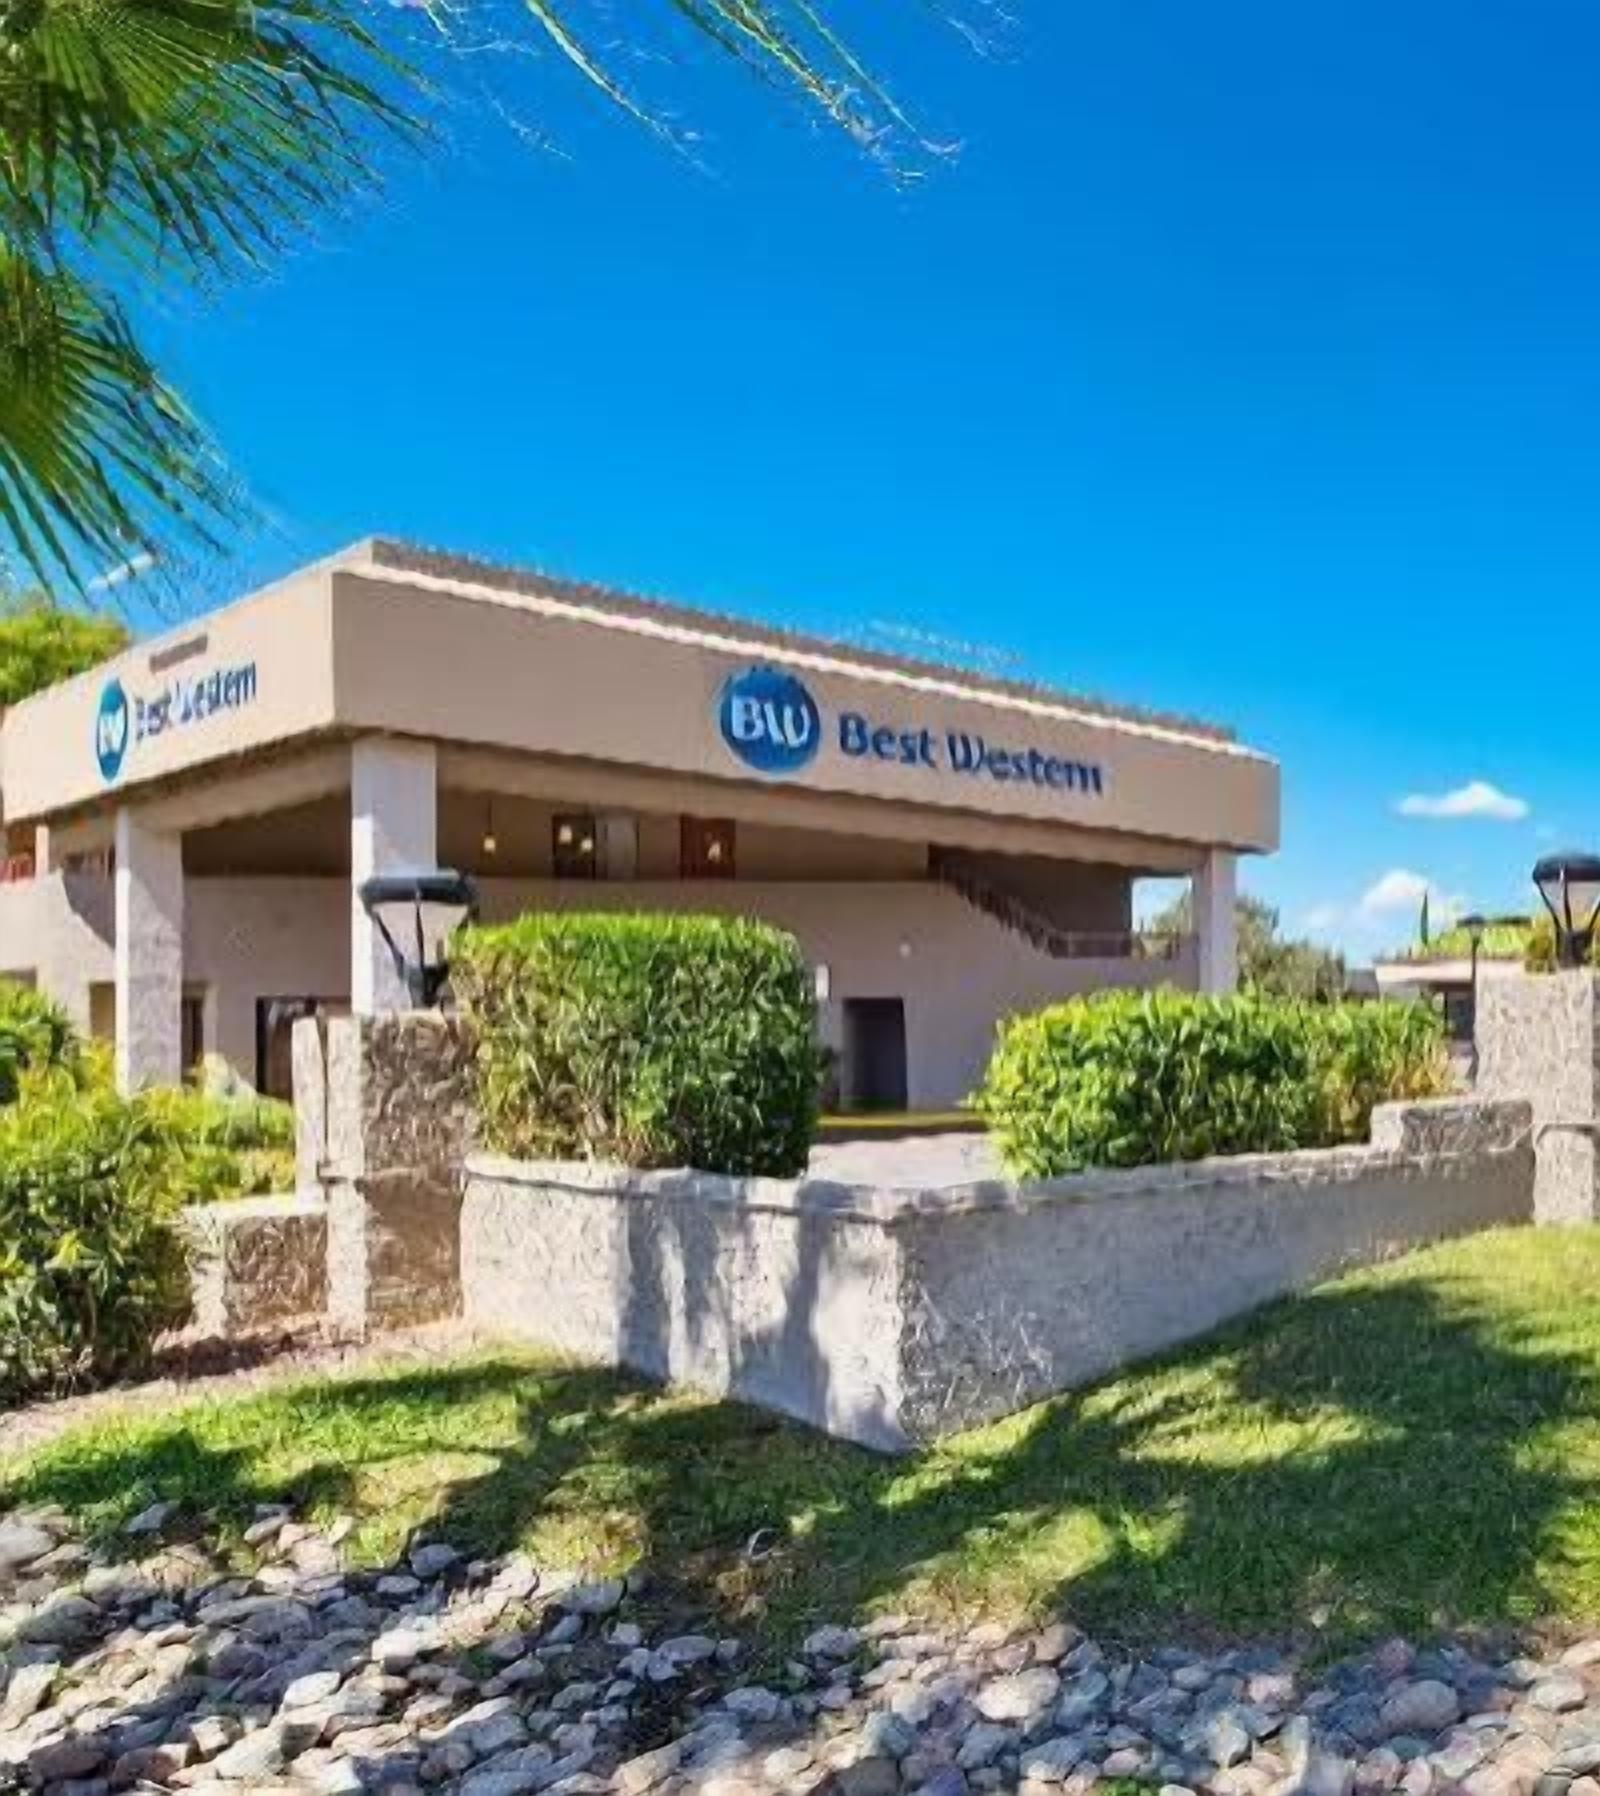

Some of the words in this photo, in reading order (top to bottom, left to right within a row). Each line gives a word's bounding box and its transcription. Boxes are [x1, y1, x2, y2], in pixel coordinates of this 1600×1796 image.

[731, 693, 811, 750] BW
[837, 711, 937, 769] Best
[944, 731, 1104, 795] Western
